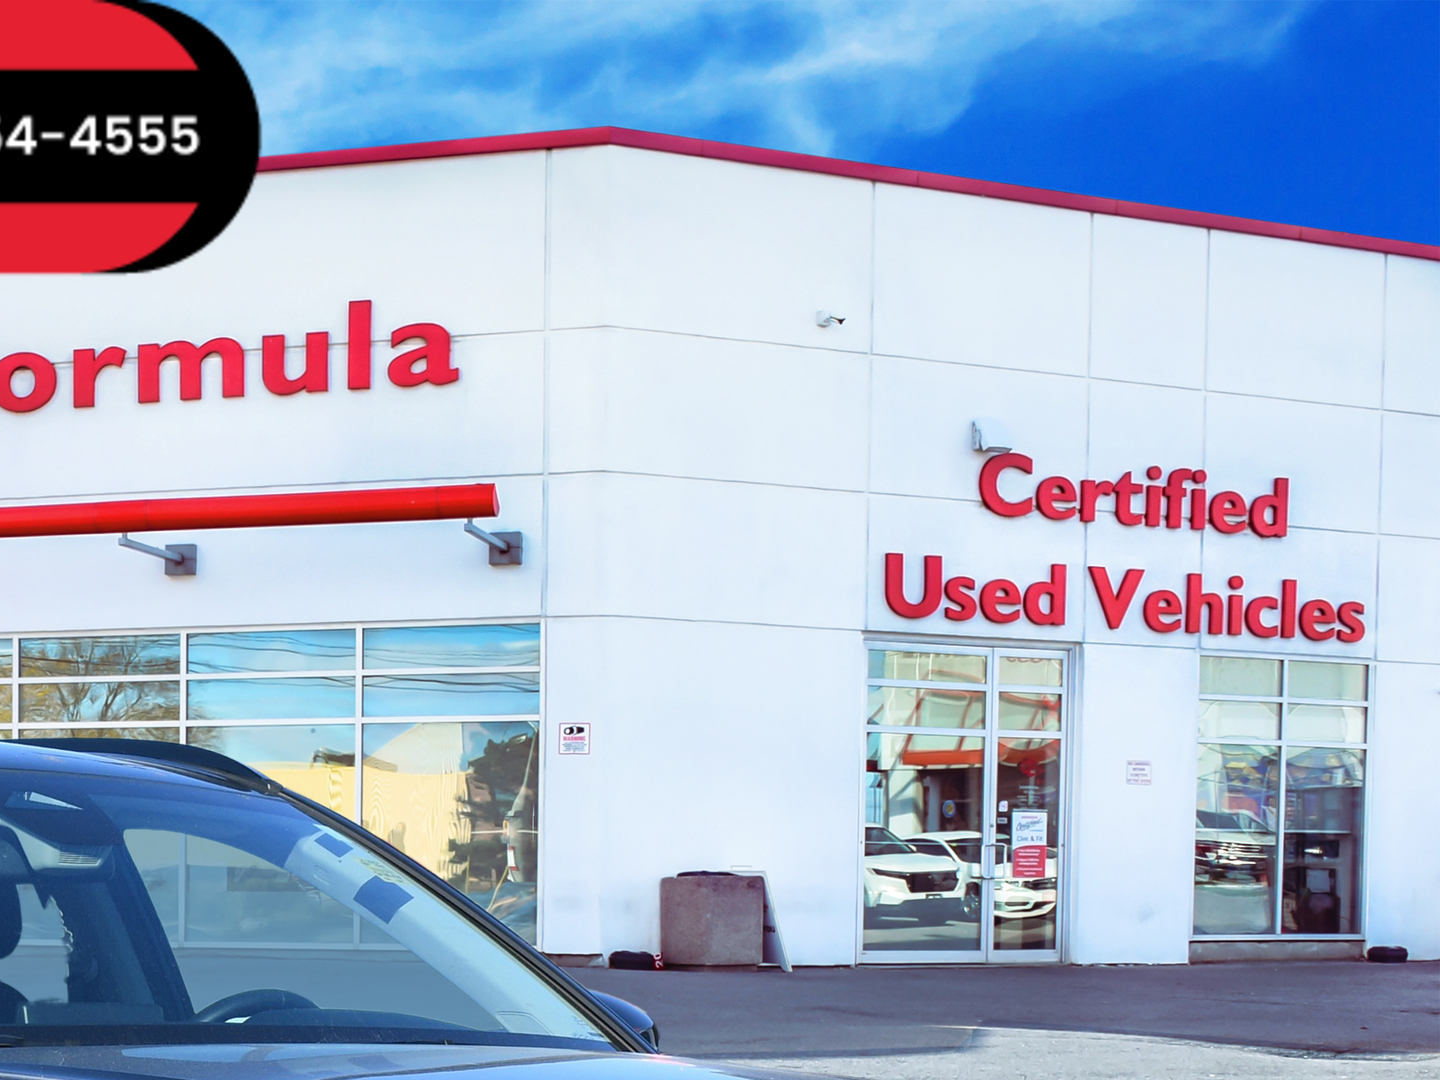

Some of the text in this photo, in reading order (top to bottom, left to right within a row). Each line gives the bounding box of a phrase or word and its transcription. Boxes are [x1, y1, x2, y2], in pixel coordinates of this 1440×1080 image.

[979, 453, 1289, 538] Certified
[884, 552, 1366, 643] Used Vehicles
